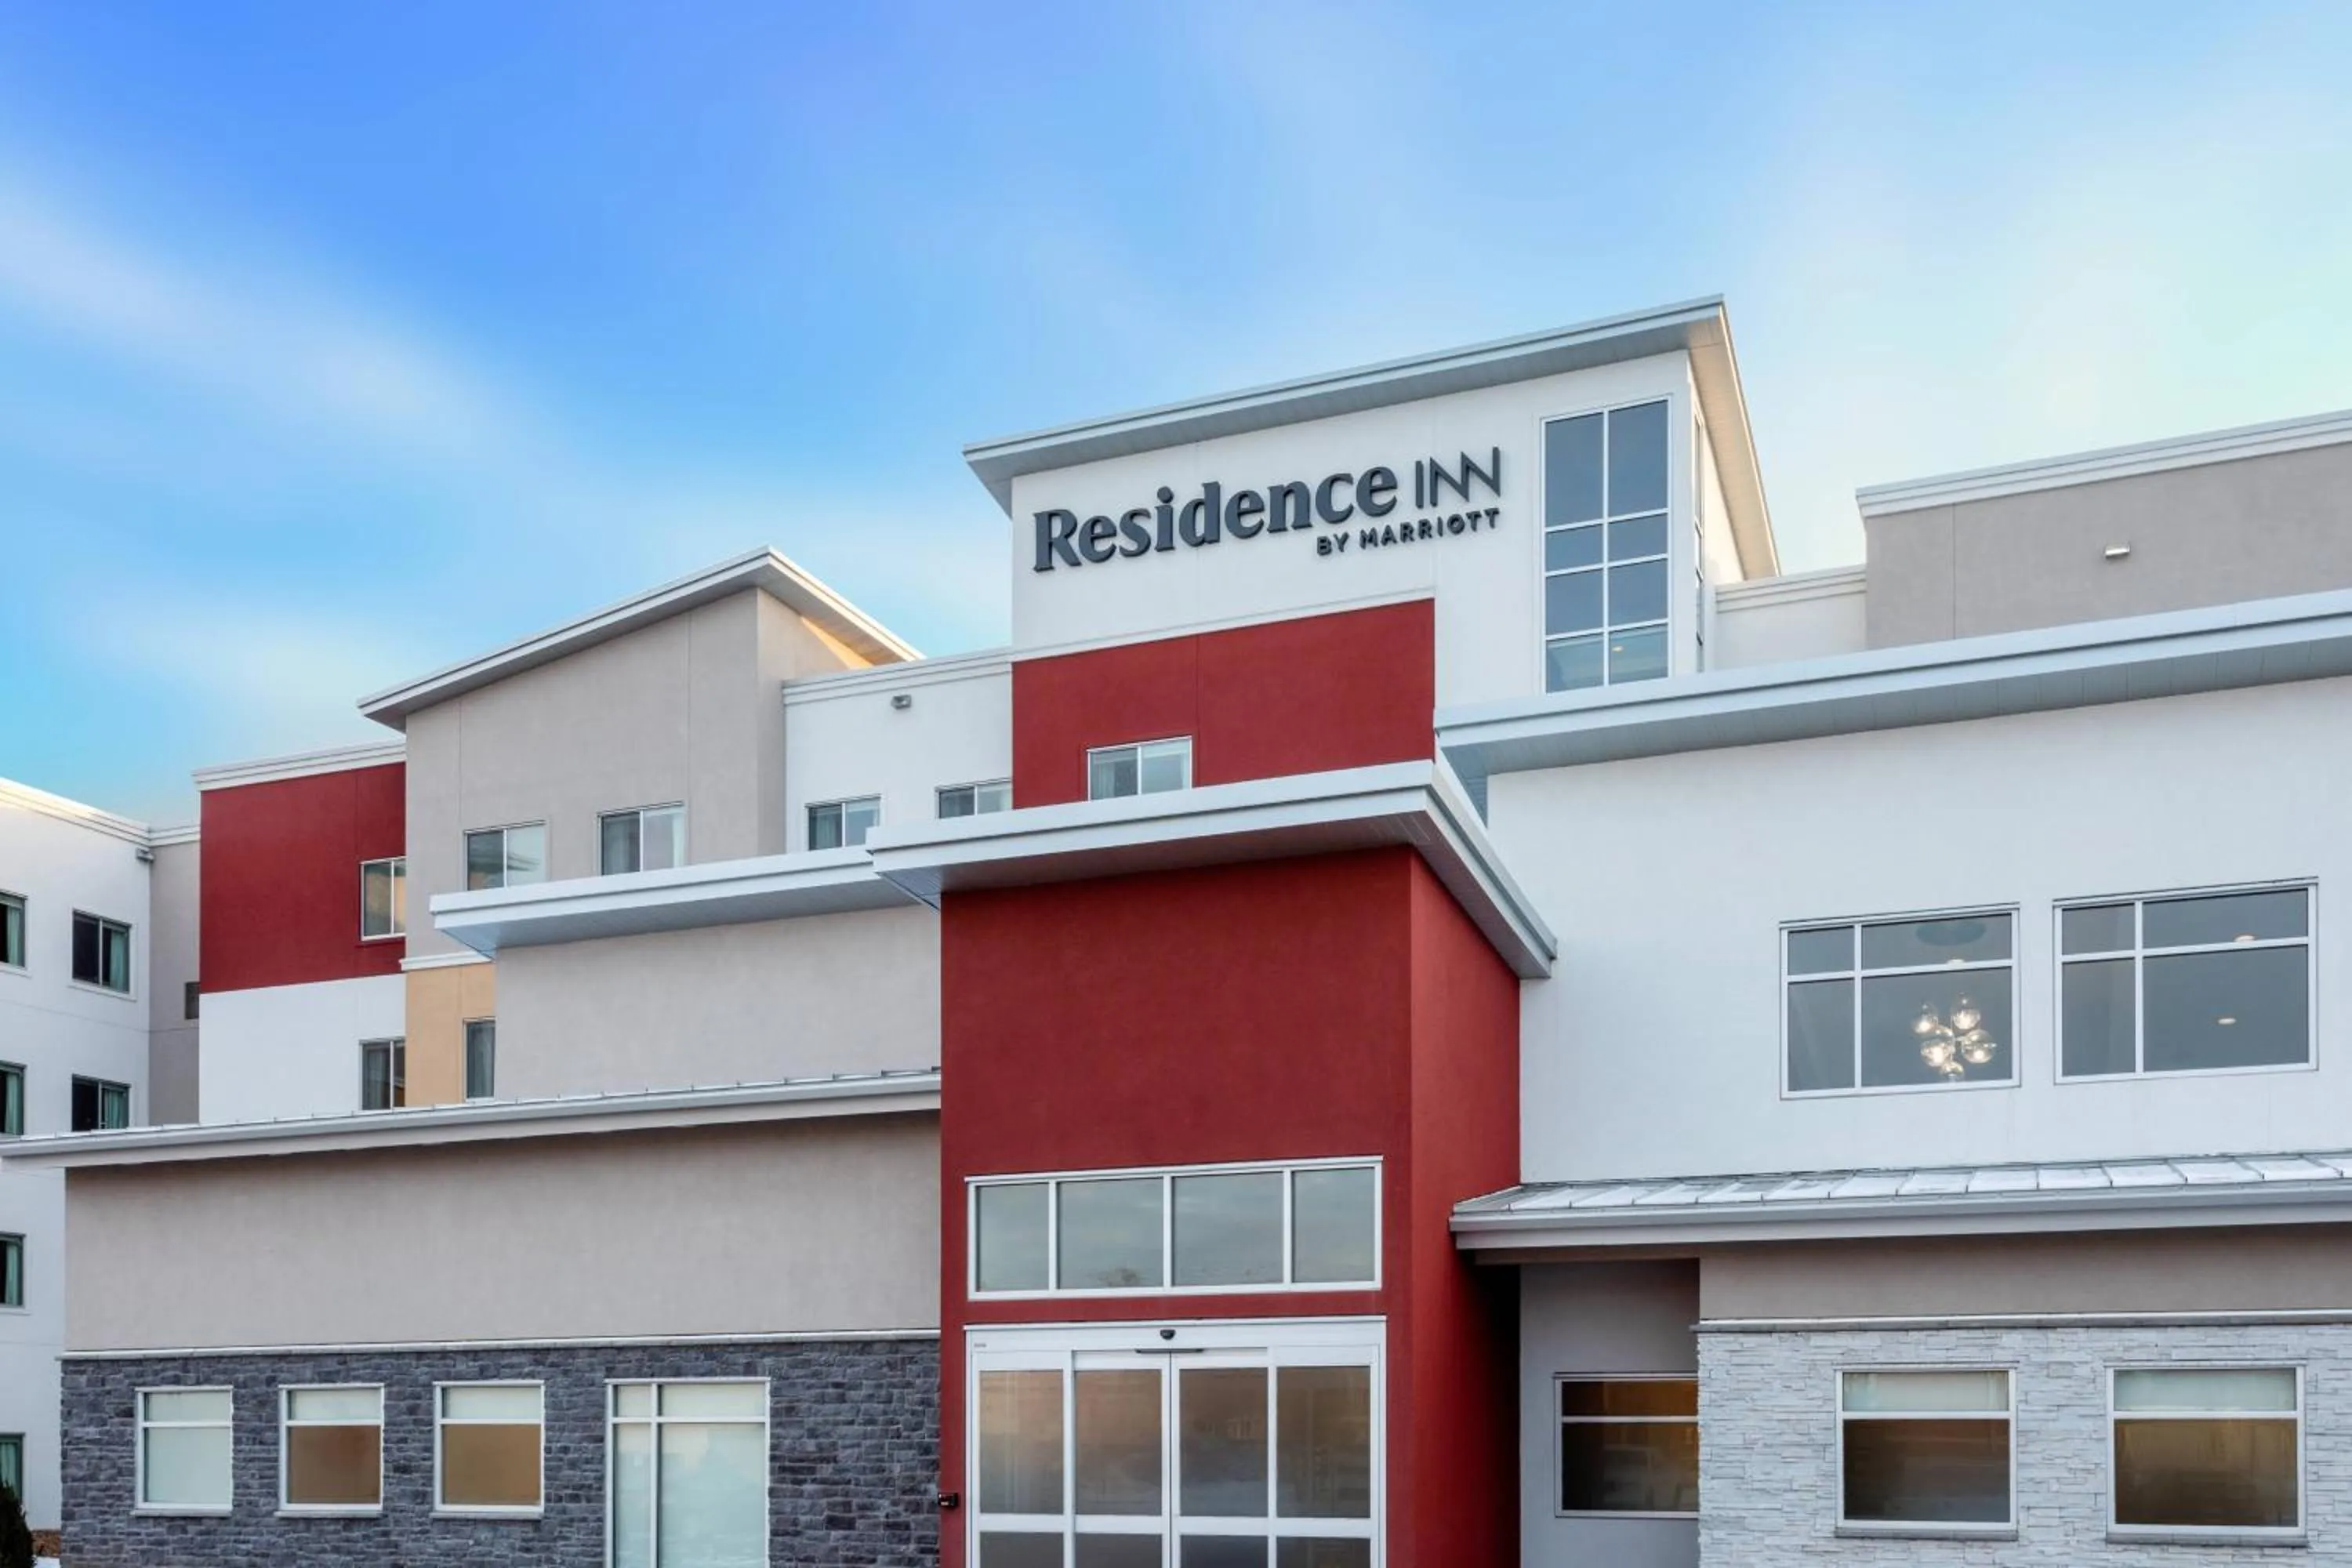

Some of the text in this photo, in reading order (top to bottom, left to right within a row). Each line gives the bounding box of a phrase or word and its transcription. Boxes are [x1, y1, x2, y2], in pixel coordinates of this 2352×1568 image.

[1033, 446, 1501, 574] Residence INN
[1316, 507, 1501, 557] BY MARRIOTT
